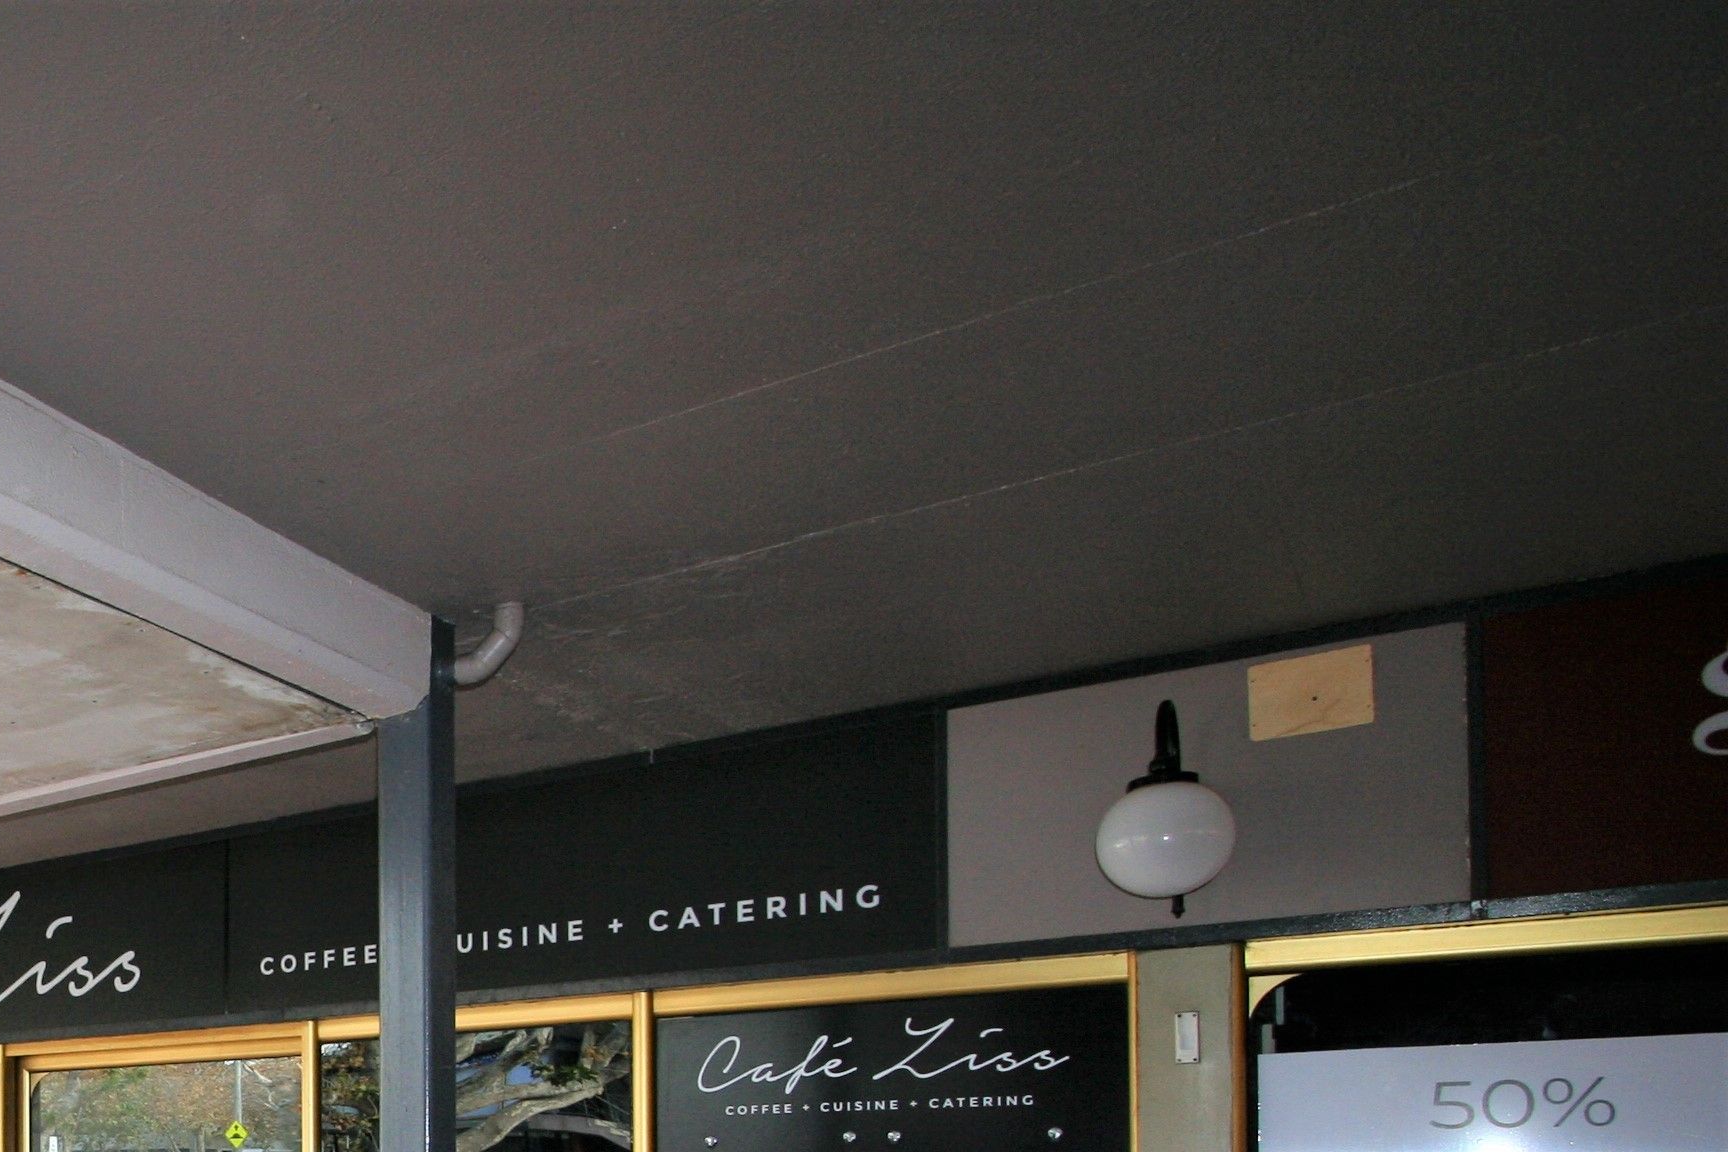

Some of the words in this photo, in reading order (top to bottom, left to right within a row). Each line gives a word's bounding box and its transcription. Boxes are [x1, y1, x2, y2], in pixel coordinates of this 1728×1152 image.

[259, 944, 377, 976] COFFEE
[456, 919, 585, 954] UISINE
[649, 884, 883, 933] CATERING
[697, 1034, 858, 1094] Café
[872, 1017, 1070, 1079] Ziss
[725, 1103, 793, 1116] COFFEE
[820, 1099, 900, 1113] CUISINE
[928, 1094, 1035, 1110] CATERING
[1429, 1076, 1616, 1130] 50%
